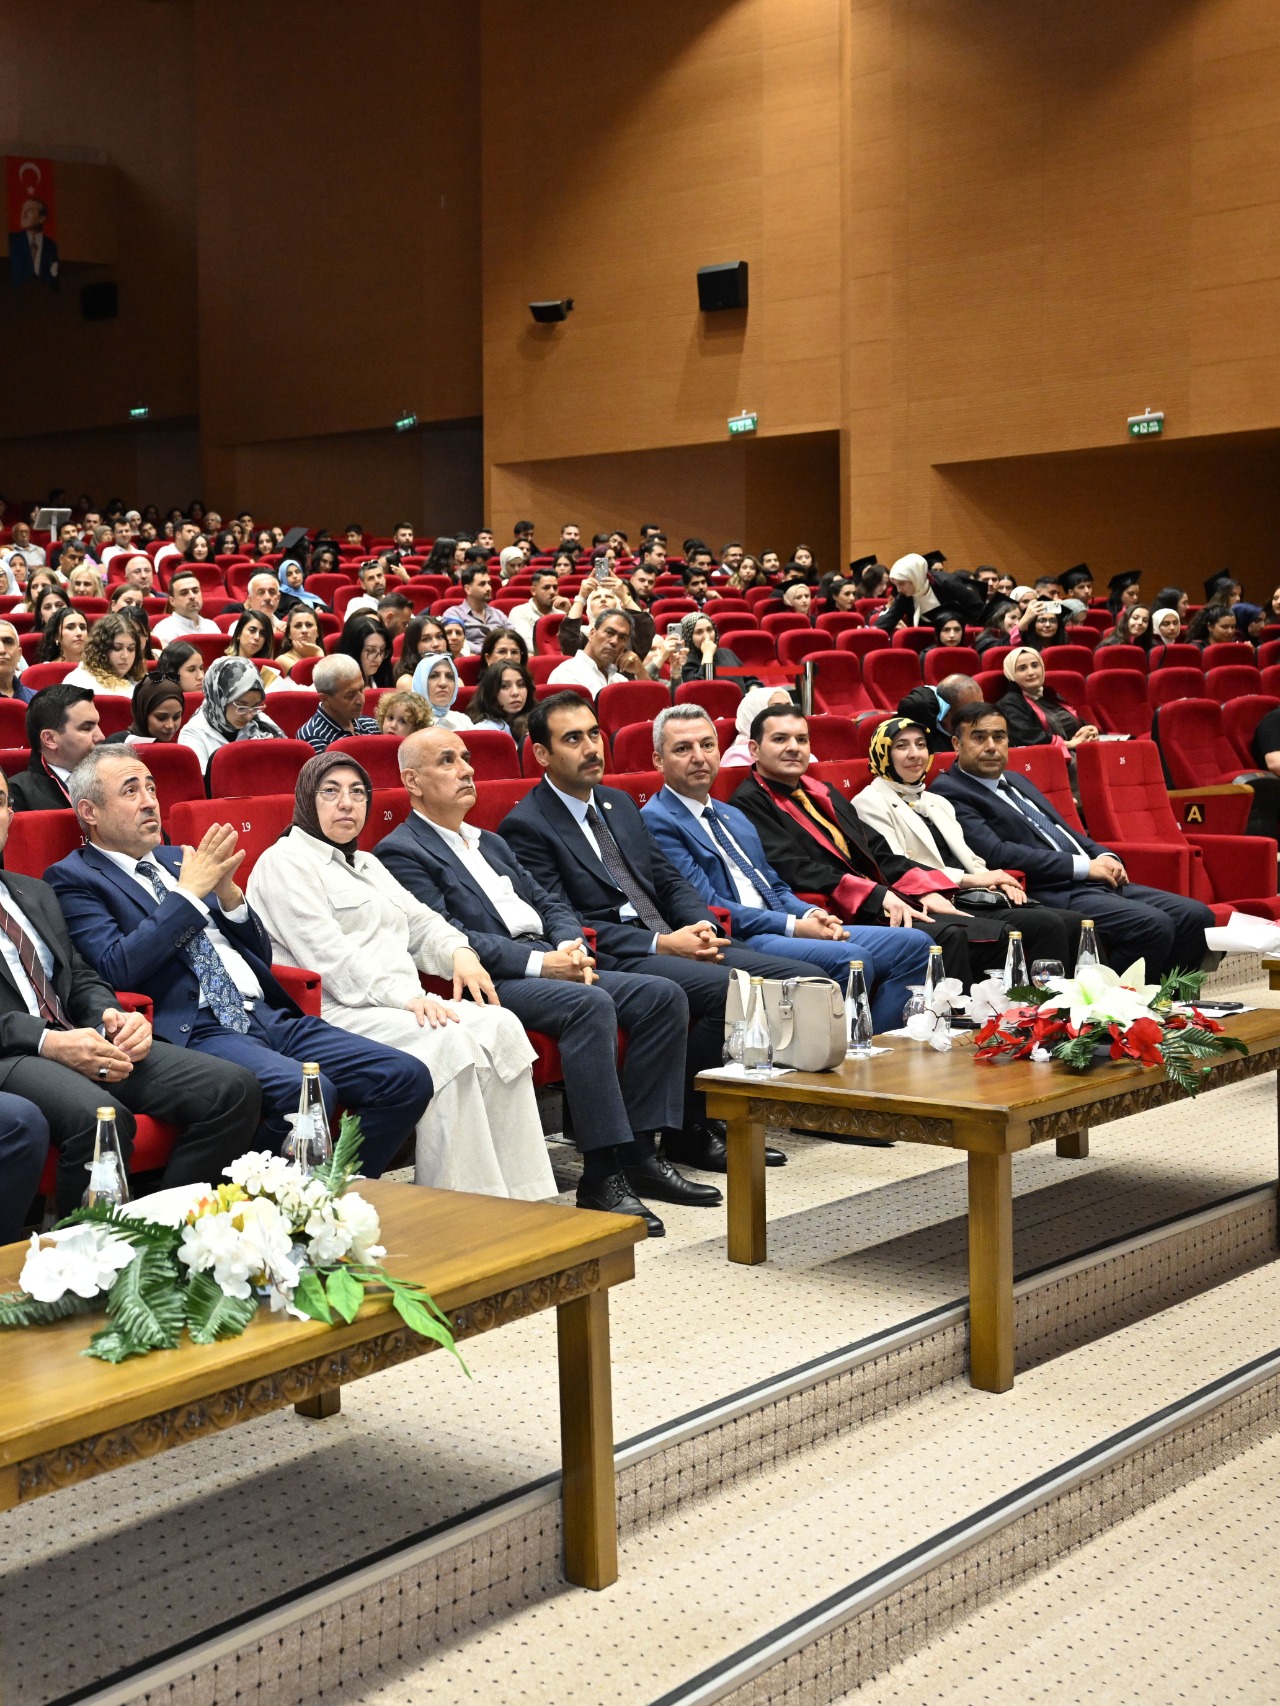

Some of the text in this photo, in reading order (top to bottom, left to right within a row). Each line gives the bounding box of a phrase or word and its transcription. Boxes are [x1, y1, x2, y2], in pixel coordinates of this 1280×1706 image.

[639, 793, 647, 803] 22
[383, 810, 393, 821] 20
[1187, 805, 1202, 822] A
[241, 821, 251, 832] 19
